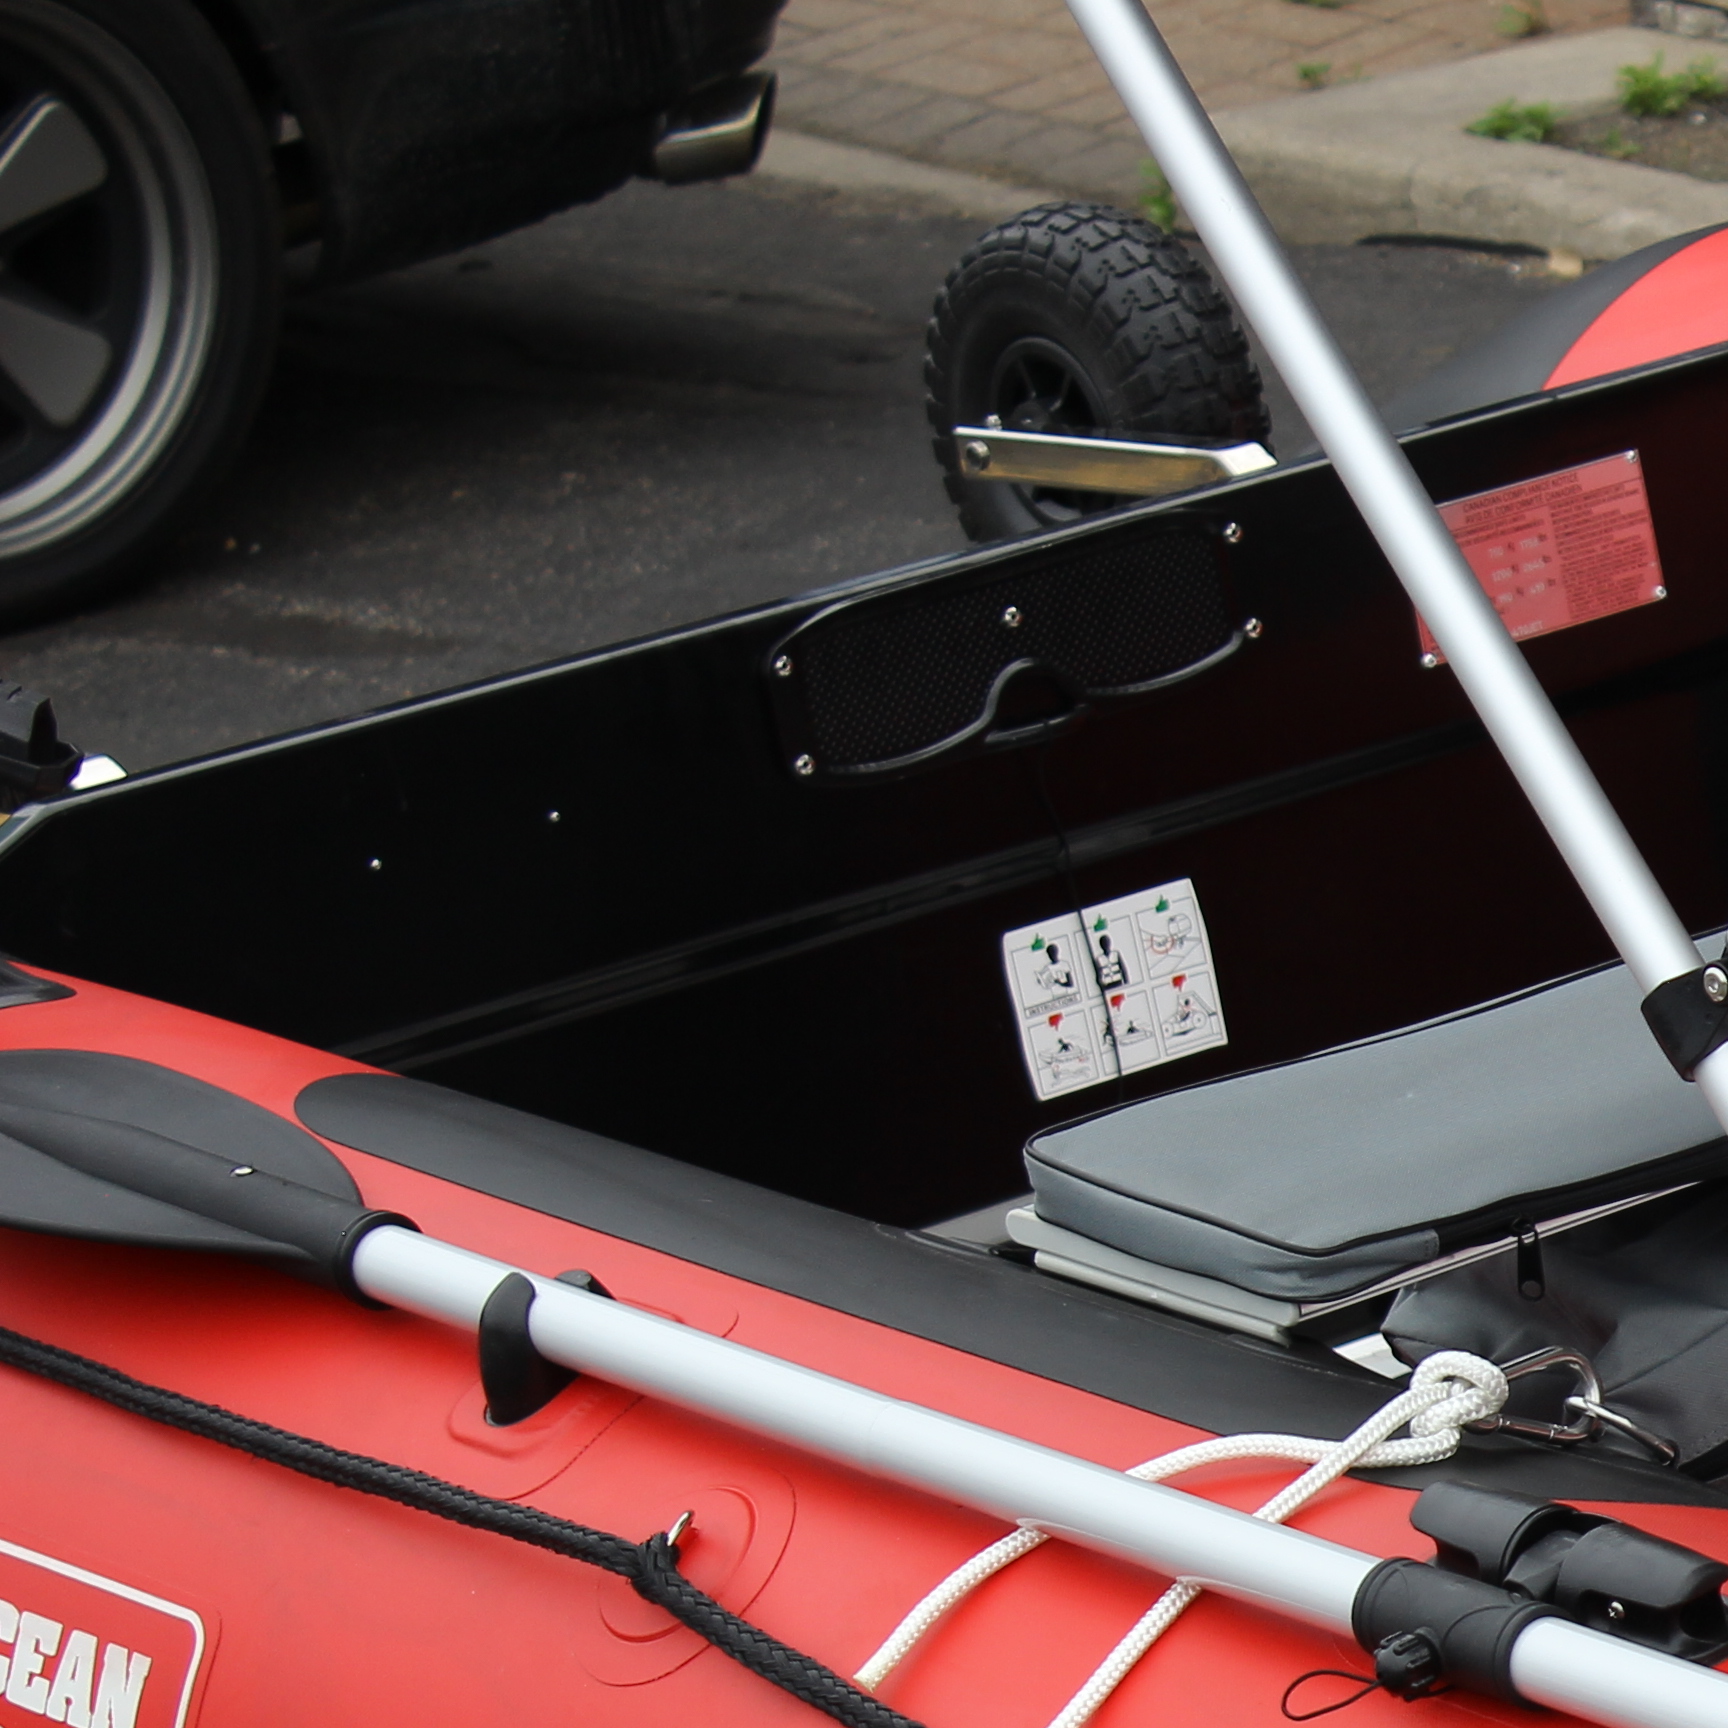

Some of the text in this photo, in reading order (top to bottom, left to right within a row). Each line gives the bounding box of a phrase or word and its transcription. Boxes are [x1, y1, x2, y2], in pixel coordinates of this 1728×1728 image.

[1463, 472, 1578, 513] CANADIAN COMPLIANCE NOTICE
[1483, 506, 1494, 518] DE
[1544, 484, 1583, 505] CANADIEN
